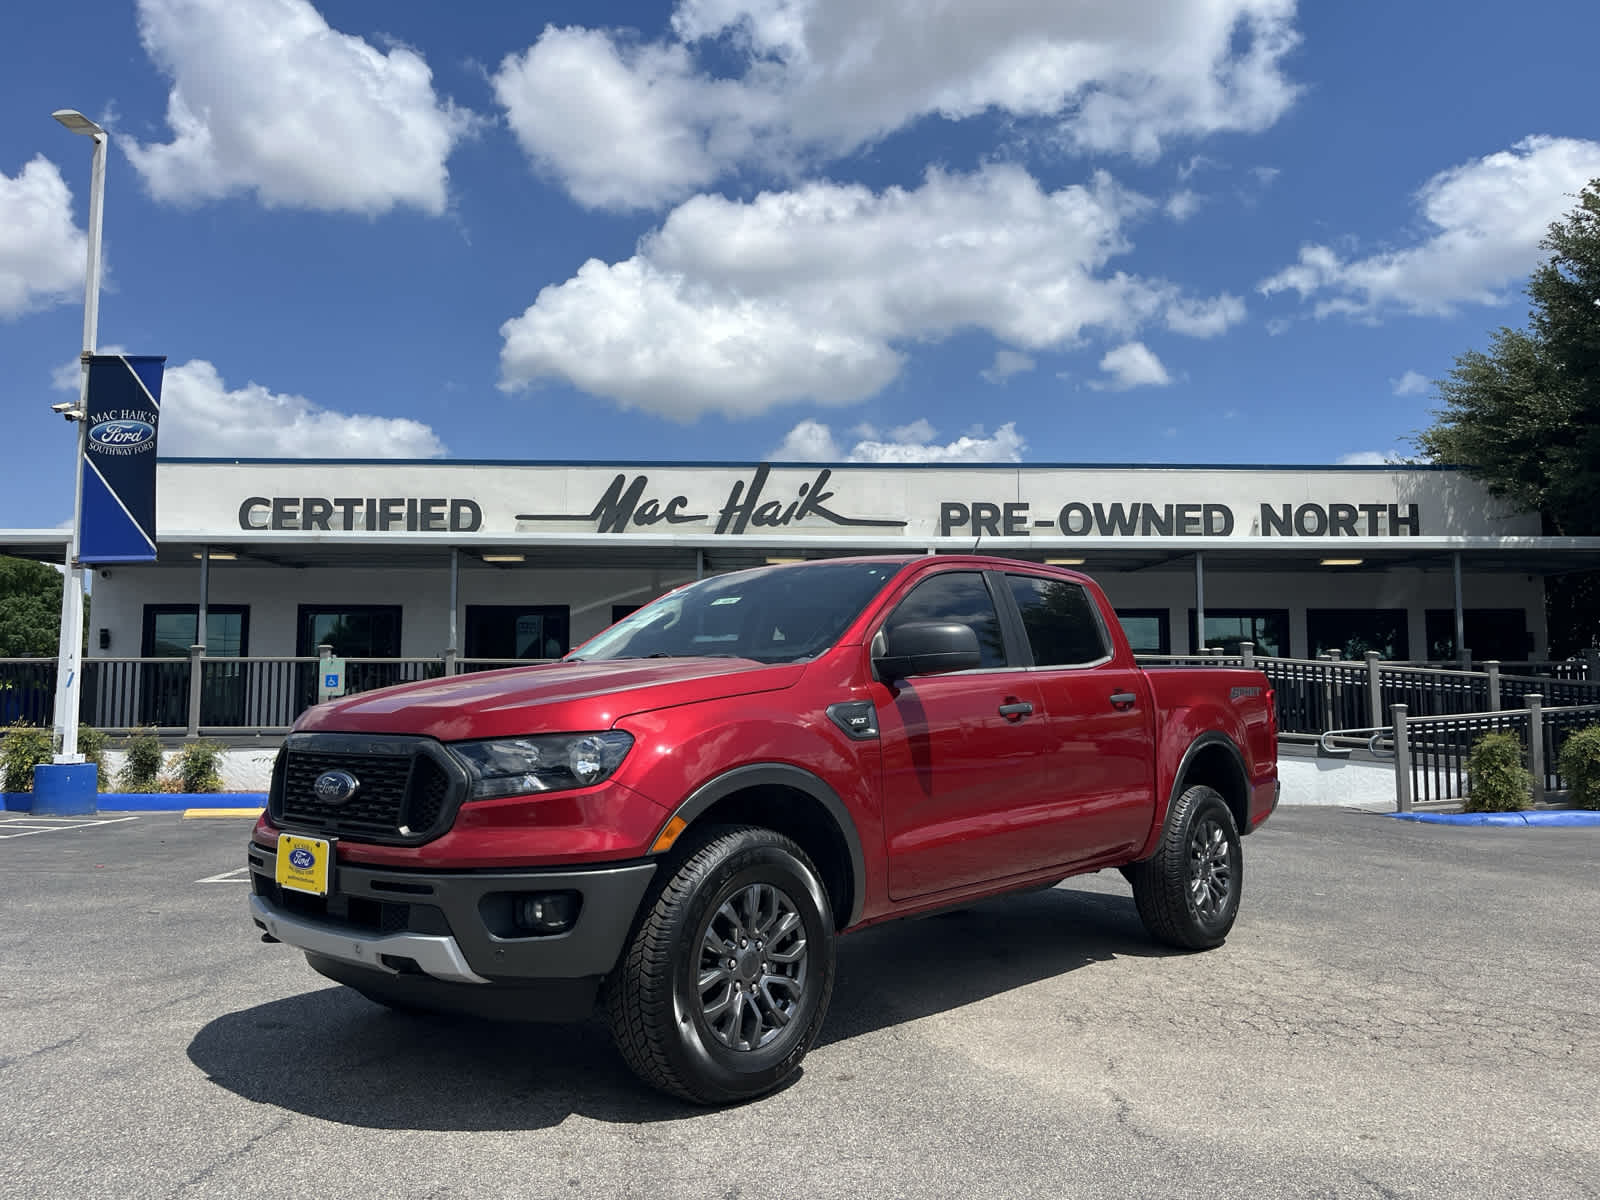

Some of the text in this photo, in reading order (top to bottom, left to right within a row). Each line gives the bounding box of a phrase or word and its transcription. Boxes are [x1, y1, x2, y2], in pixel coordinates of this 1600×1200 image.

[91, 409, 157, 424] MAC HAIK'S
[101, 423, 144, 442] Ford
[88, 441, 154, 455] SOUTHWAY FORD
[515, 463, 907, 535] Mac Haik
[238, 496, 483, 532] CERTIFIED
[940, 502, 1420, 537] PRE-OWNED NORTH
[319, 776, 342, 795] Ford
[293, 850, 311, 866] Ford
